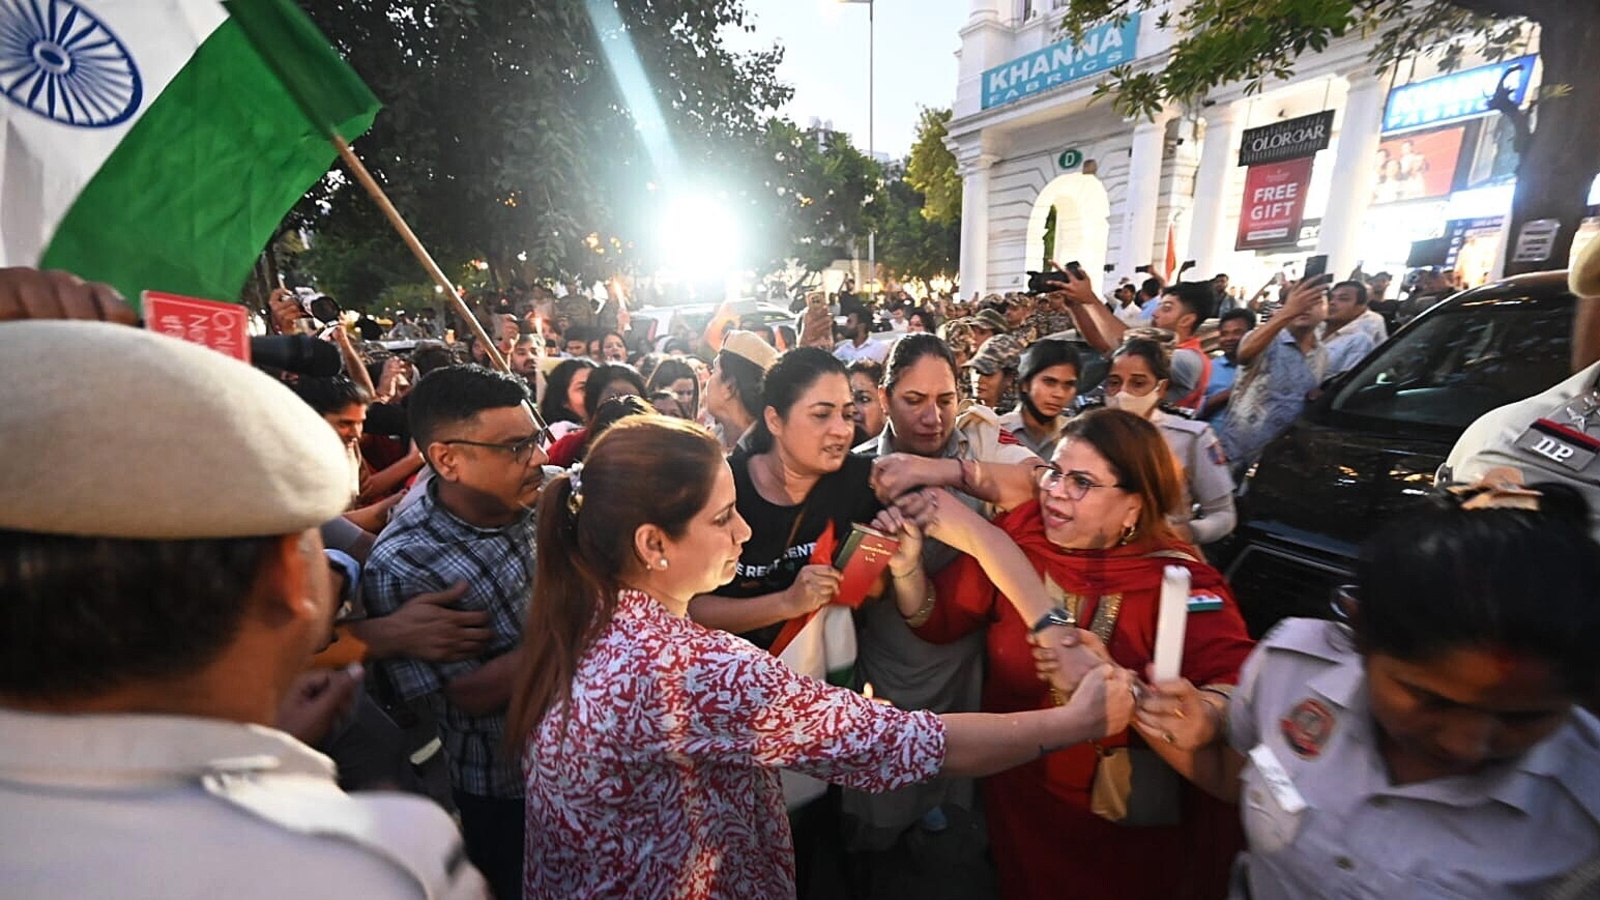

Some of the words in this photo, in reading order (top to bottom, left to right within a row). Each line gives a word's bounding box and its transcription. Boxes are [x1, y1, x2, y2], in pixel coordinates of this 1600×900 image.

[990, 27, 1123, 93] KHANNA
[989, 51, 1122, 105] FABRICS
[1065, 152, 1075, 166] D
[1253, 182, 1298, 203] FREE
[1250, 201, 1295, 220] GIFT
[1532, 437, 1574, 462] DP
